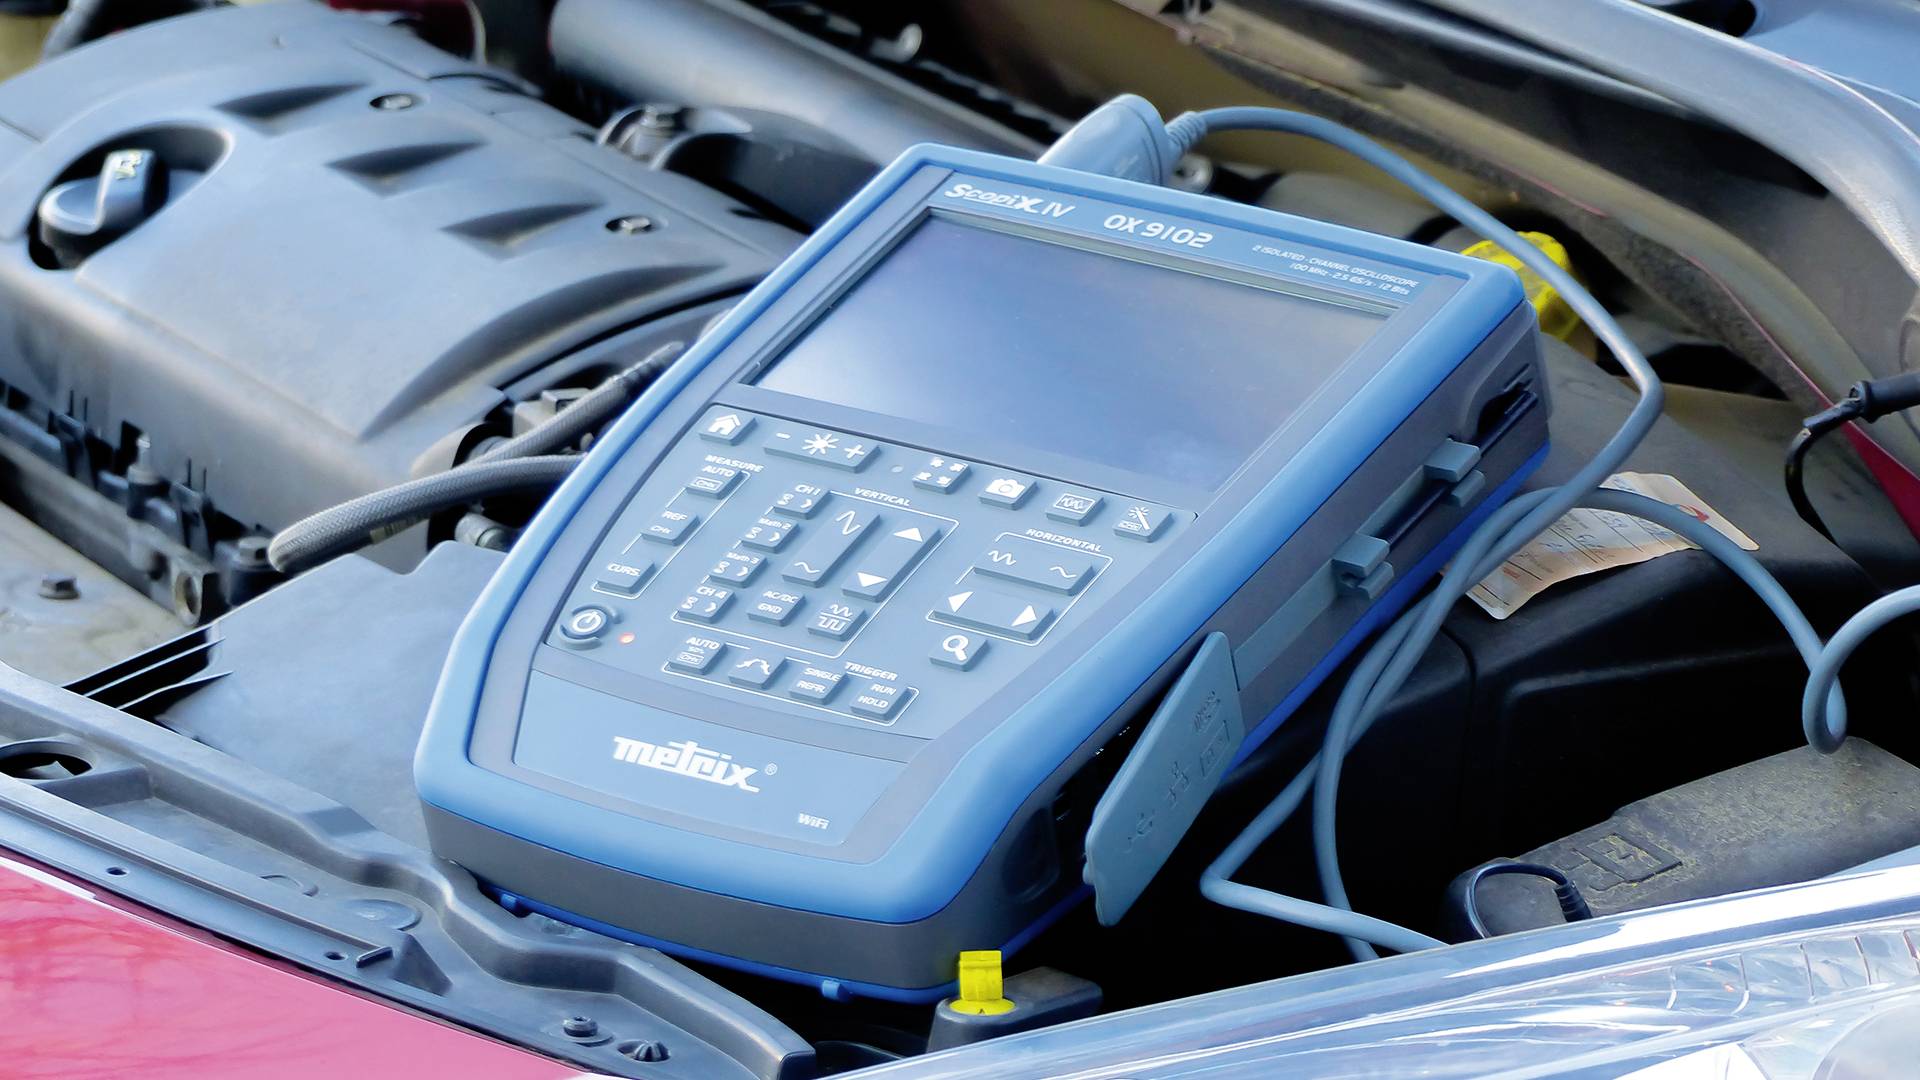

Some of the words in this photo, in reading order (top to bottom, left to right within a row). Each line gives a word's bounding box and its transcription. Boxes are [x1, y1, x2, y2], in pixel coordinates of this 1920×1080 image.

[1041, 201, 1076, 218] IV
[1103, 214, 1143, 233] OX
[1141, 222, 1214, 249] 9102
[1261, 246, 1305, 261] ISOLATED
[1309, 257, 1350, 272] CHANNEL
[1351, 267, 1420, 289] OSCILLOSCOPE
[1289, 263, 1308, 272] 100
[1308, 267, 1329, 277] MHz
[1379, 282, 1390, 291] 12
[1390, 285, 1410, 296] Bits
[704, 454, 765, 473] MEASURE
[702, 465, 736, 478] AUTO
[795, 483, 812, 495] CH
[854, 487, 912, 507] VERTICAL
[661, 510, 688, 521] REF
[758, 517, 782, 529] Math
[781, 522, 793, 531] 2
[1025, 528, 1104, 553] HORIZONTAL
[726, 551, 750, 563] Math
[750, 556, 761, 565] 3
[696, 585, 712, 597] CH
[713, 590, 728, 600] 4
[762, 590, 799, 604] AC/DC
[757, 602, 783, 614] GND
[686, 636, 721, 650] AUTO
[804, 667, 842, 682] SINGLE
[845, 660, 898, 681] TRIGGER
[870, 683, 898, 696] RUN
[857, 695, 889, 709] HOLD
[613, 735, 761, 793] metrix
[797, 812, 830, 830] WiFi
